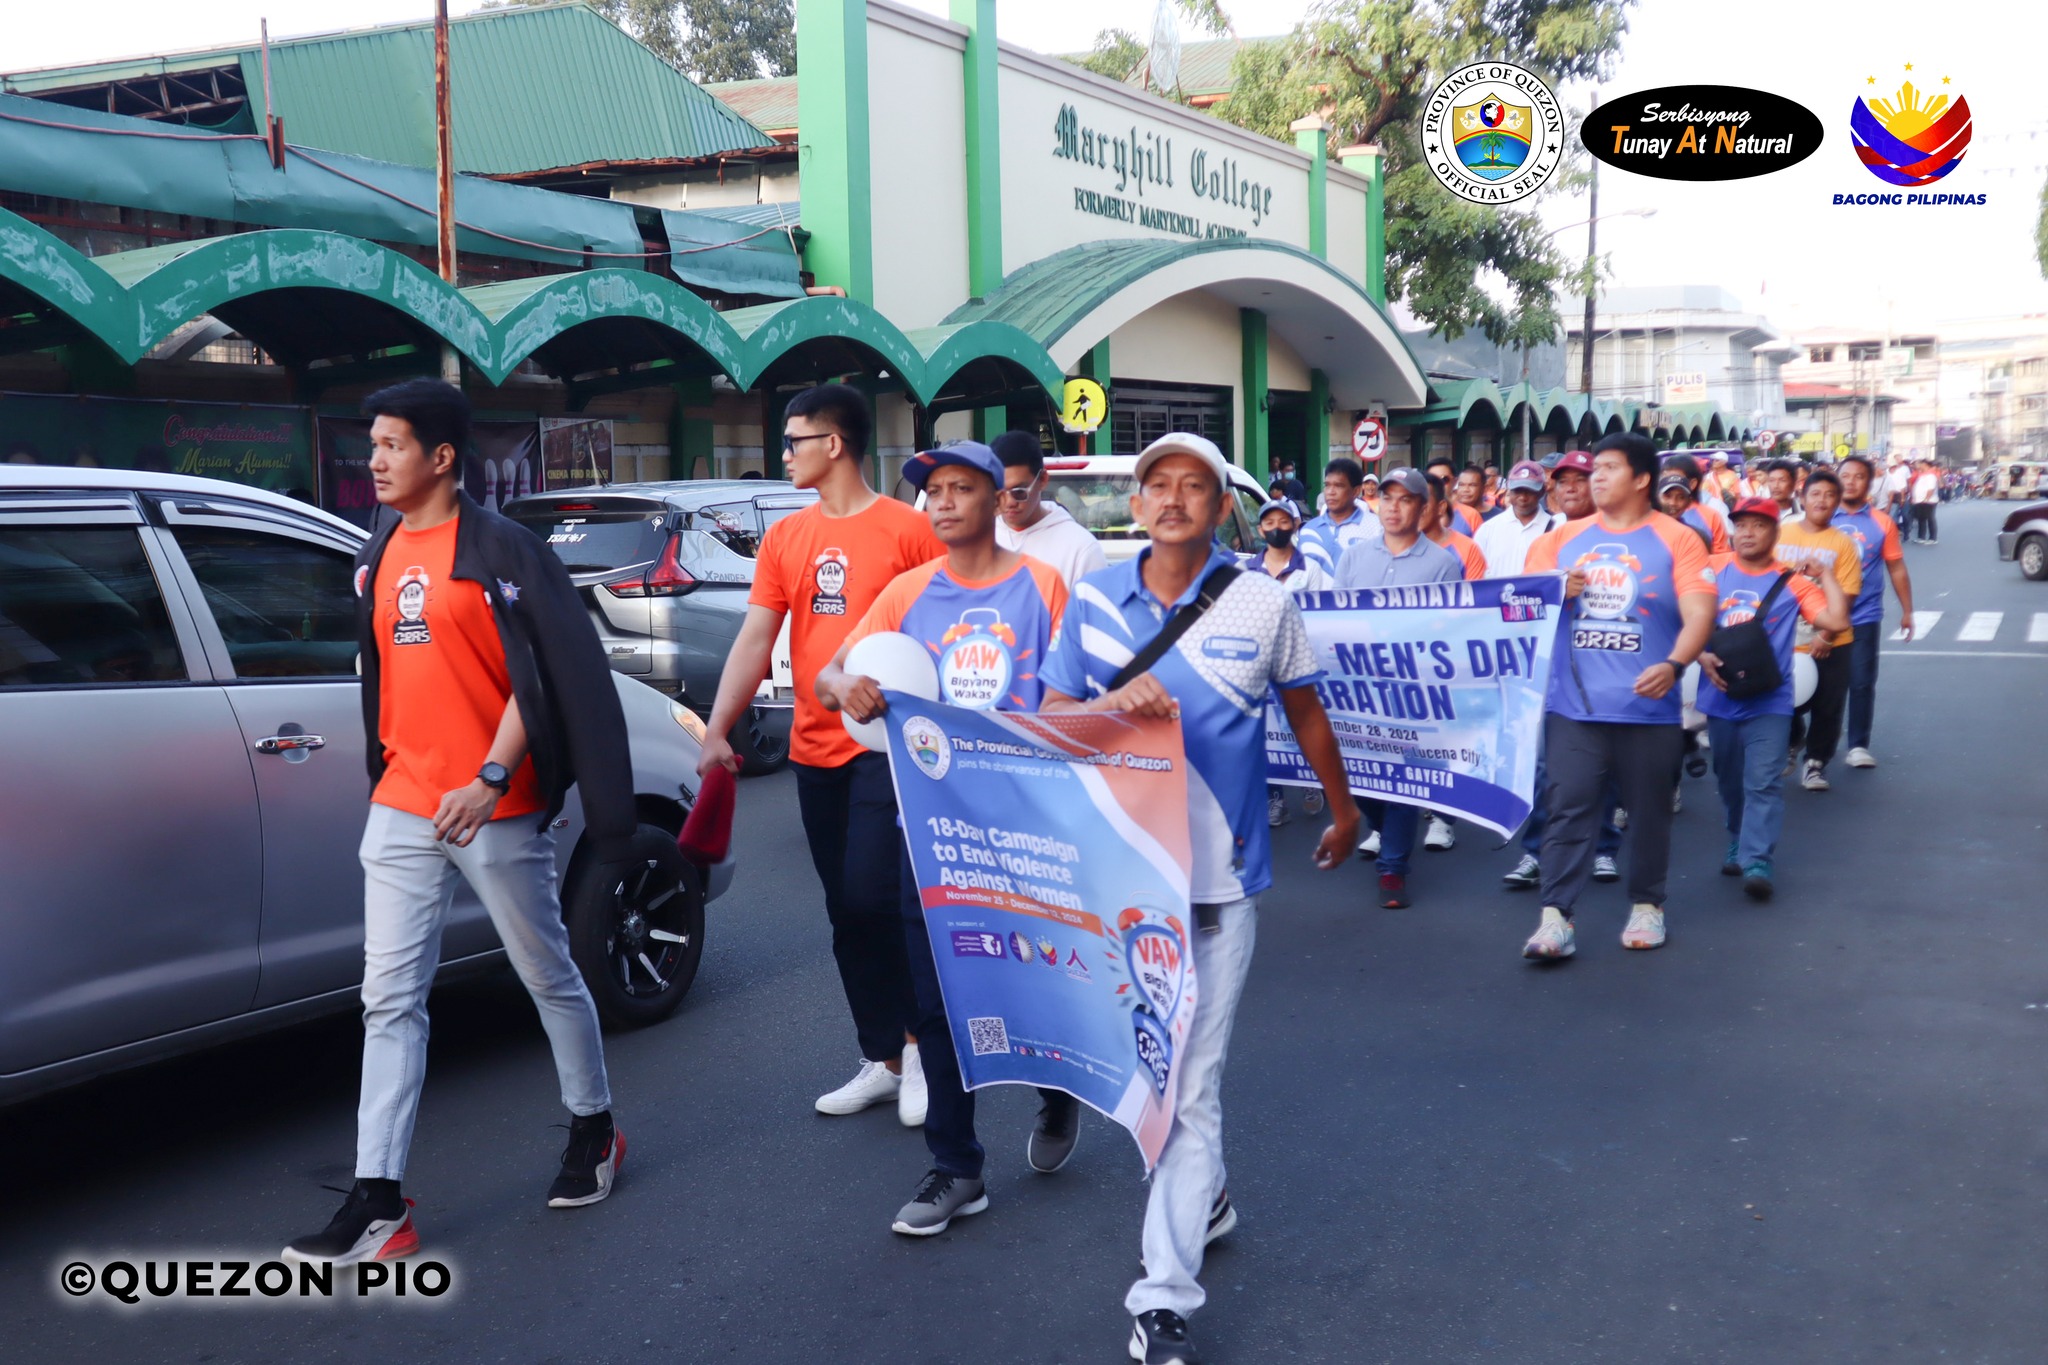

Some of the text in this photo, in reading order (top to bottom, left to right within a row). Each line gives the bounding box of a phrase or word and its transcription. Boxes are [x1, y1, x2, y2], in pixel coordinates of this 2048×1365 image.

[1053, 102, 1272, 227] Maryhill College
[1074, 187, 1136, 224] FORMERLY
[1139, 204, 1203, 239] MARYKNOLL
[1667, 374, 1703, 386] PULIS
[176, 448, 292, 475] Marian Alumni!!
[547, 469, 568, 480] CINEMA
[821, 565, 842, 576] VAW
[1584, 568, 1628, 588] VAW
[1333, 590, 1360, 608] OF
[1370, 583, 1475, 608] SARIAYA
[1511, 596, 1543, 605] Gilas
[1584, 591, 1626, 602] Bigyang
[1589, 601, 1621, 609] Wakas
[813, 603, 845, 615] ORAS
[1503, 605, 1547, 620] SARIAYA
[1574, 631, 1640, 651] ORAS
[954, 644, 1000, 670] VAW
[1334, 636, 1539, 680] MEN'S DAY
[951, 677, 997, 688] Bigyang
[954, 690, 992, 699] Wakas
[1388, 728, 1418, 741] 2024
[951, 737, 974, 751] The
[977, 739, 1033, 757] Provincial
[1111, 752, 1122, 766] of
[1125, 753, 1172, 772] Quezon
[1412, 747, 1457, 760] Lucena
[1461, 748, 1480, 767] City
[957, 759, 977, 770] joins
[980, 760, 992, 770] the
[1043, 767, 1054, 777] of
[1055, 768, 1070, 779] the
[1405, 766, 1453, 788] GAYETA
[1397, 782, 1430, 798] BAYAN
[927, 817, 1080, 863] 18-Day Campaign
[932, 841, 1074, 887] to End Violence
[941, 867, 1084, 911] Against Women
[946, 891, 992, 903] November
[1010, 899, 1049, 916] December
[1136, 937, 1181, 976] VAW
